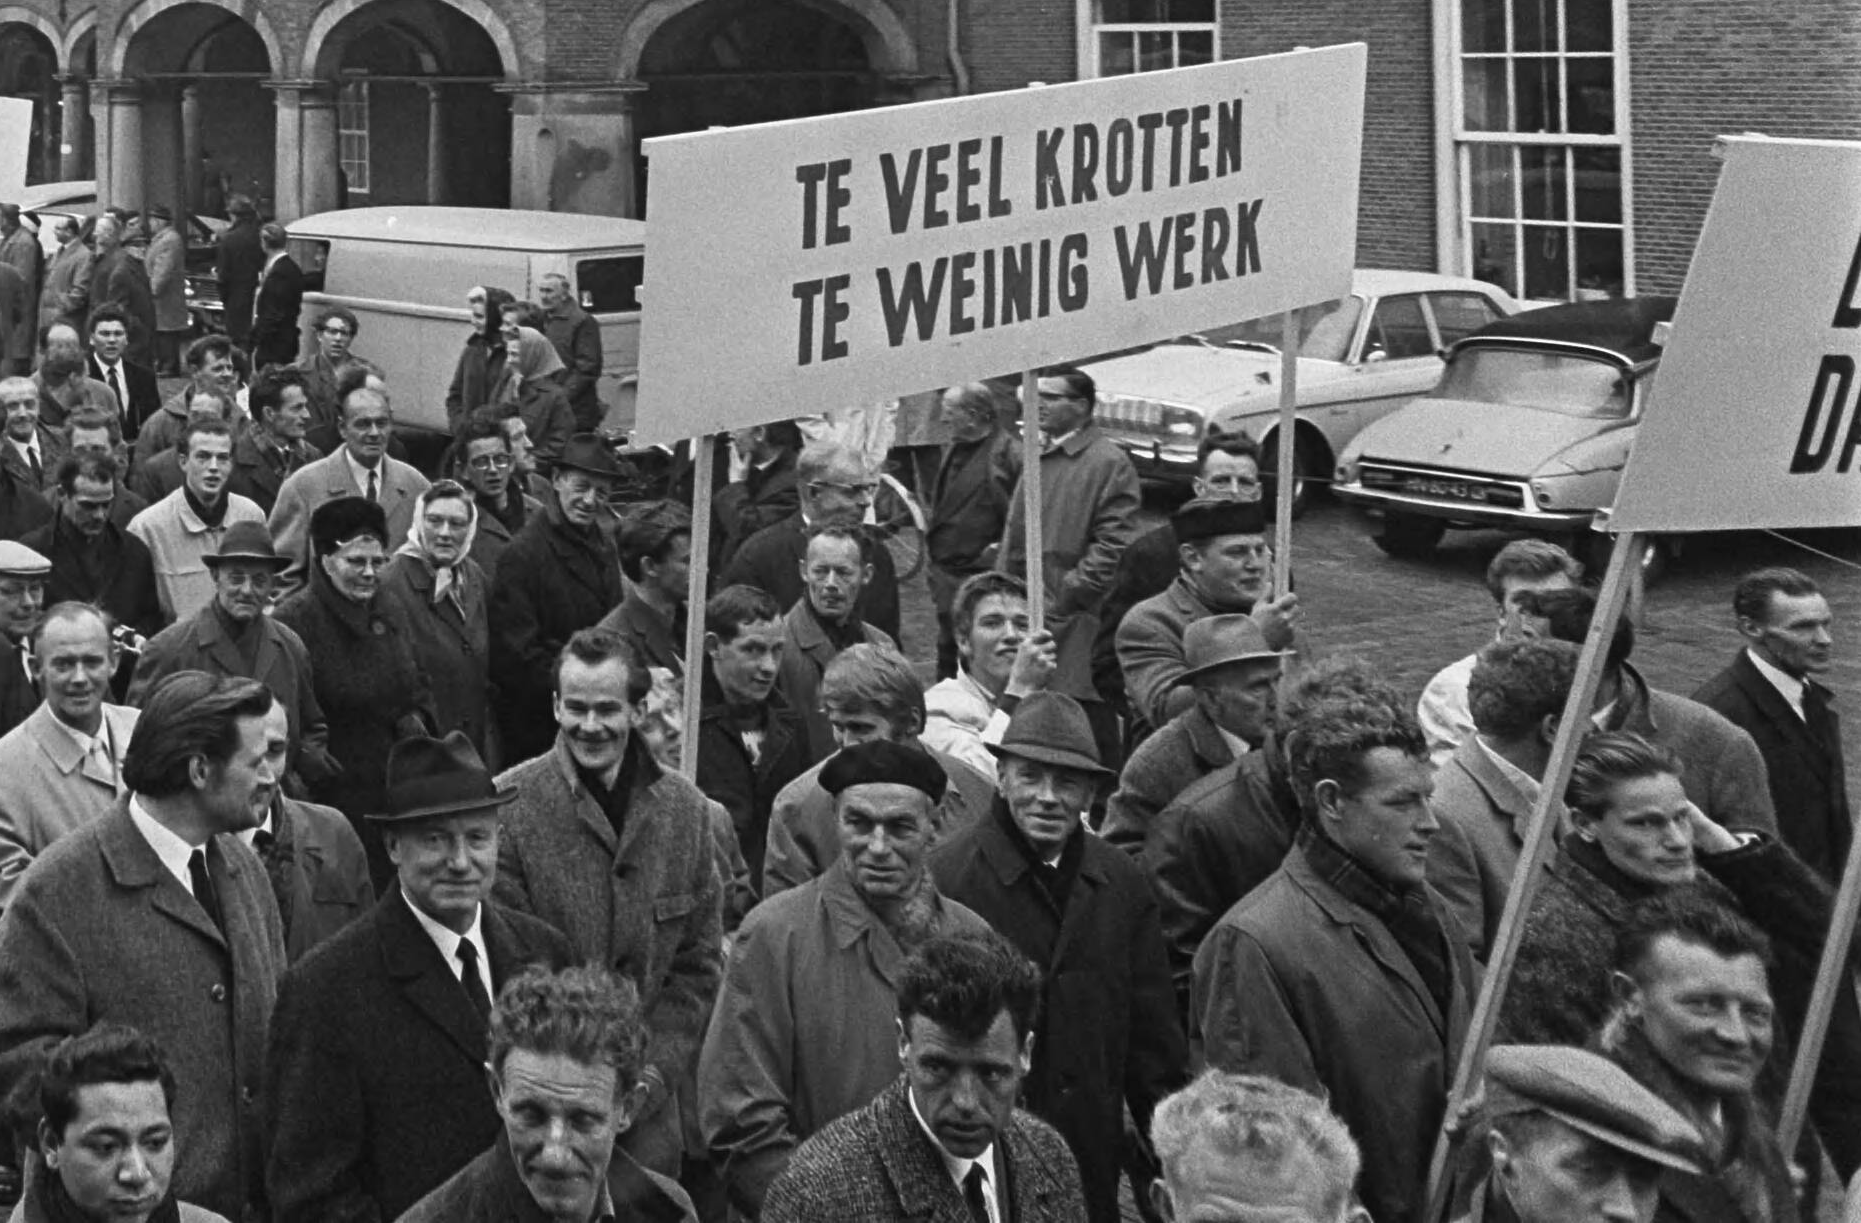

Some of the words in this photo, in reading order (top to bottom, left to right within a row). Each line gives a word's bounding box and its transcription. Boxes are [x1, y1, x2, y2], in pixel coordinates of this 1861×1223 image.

[796, 158, 852, 249] TE
[880, 136, 1012, 234] VEEL
[1035, 98, 1244, 211] KROTTEN
[792, 274, 851, 366] TE
[875, 232, 1088, 347] WEINIG
[1114, 199, 1263, 301] WERK
